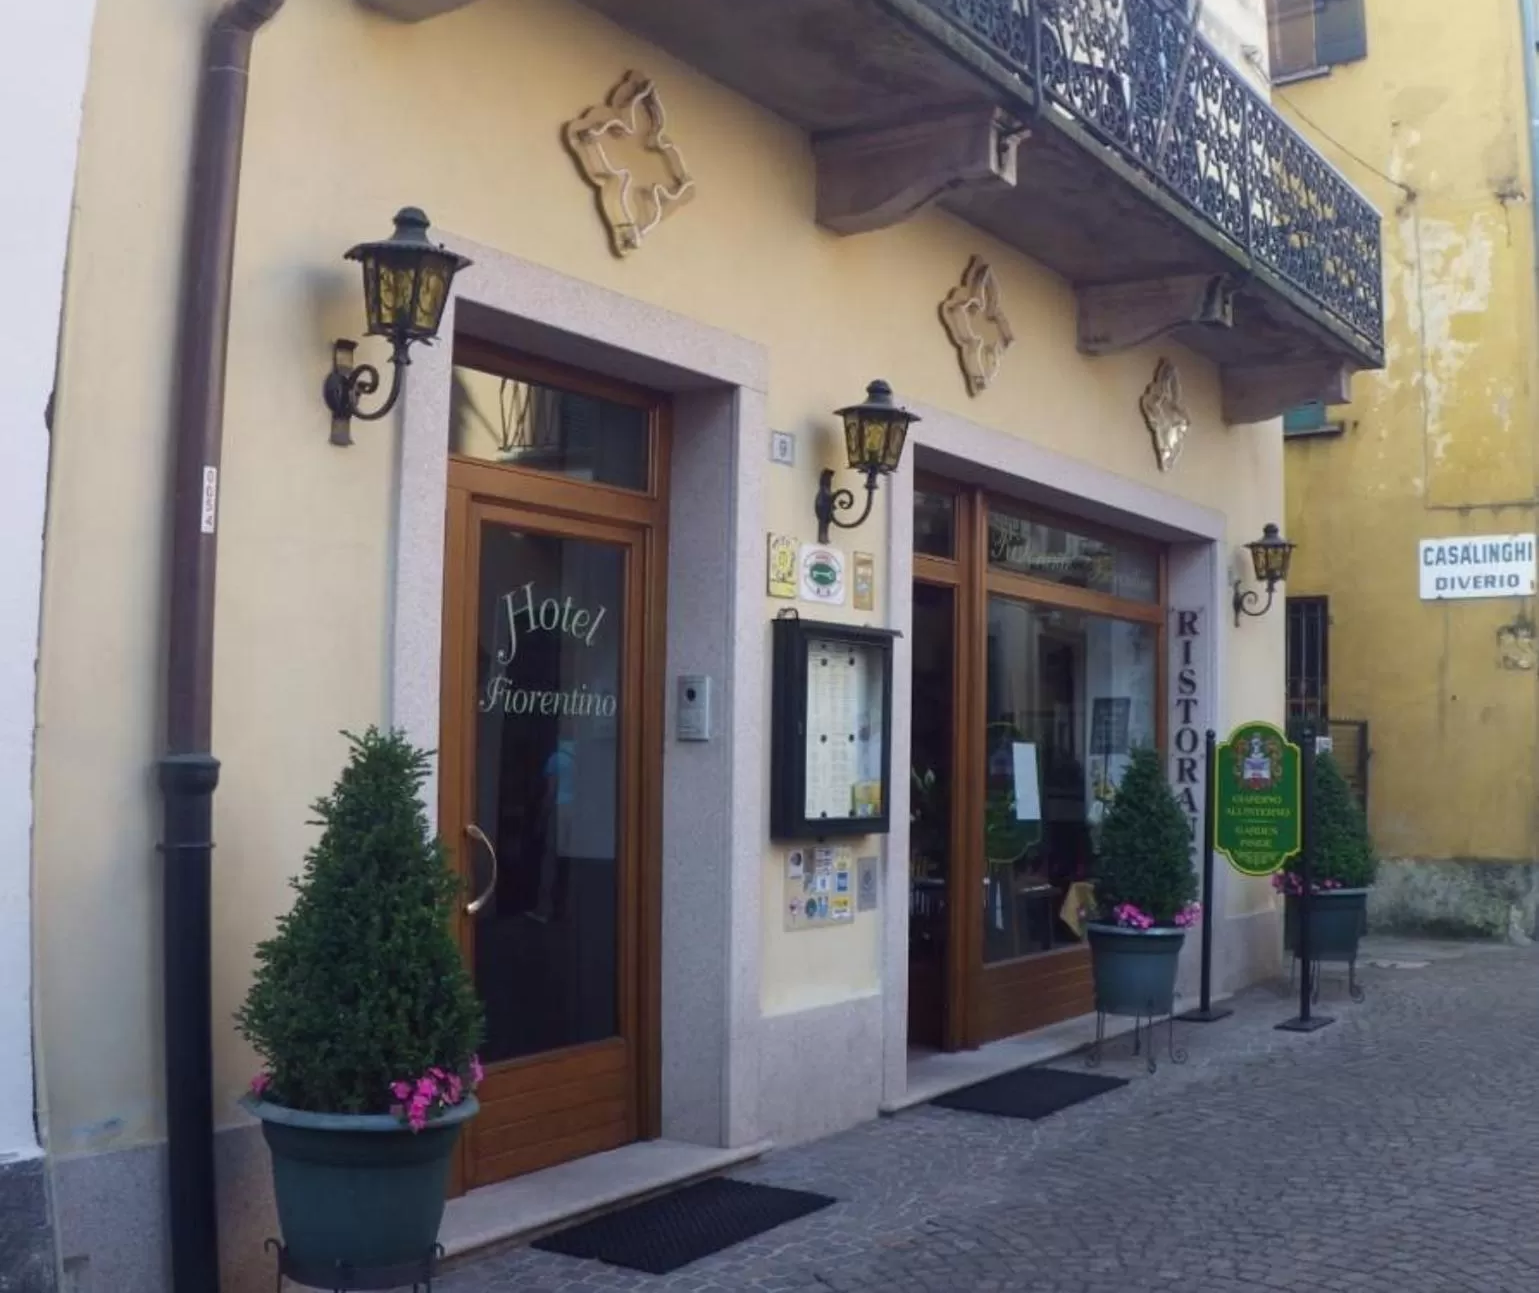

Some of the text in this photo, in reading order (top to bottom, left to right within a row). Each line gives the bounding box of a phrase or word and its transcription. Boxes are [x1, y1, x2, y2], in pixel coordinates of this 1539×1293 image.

[1423, 541, 1532, 567] CASALINGHI
[1435, 574, 1520, 591] DIVERIO
[497, 581, 607, 665] Hotel
[479, 673, 617, 717] Fiorentino
[1175, 610, 1200, 840] RISTORA
